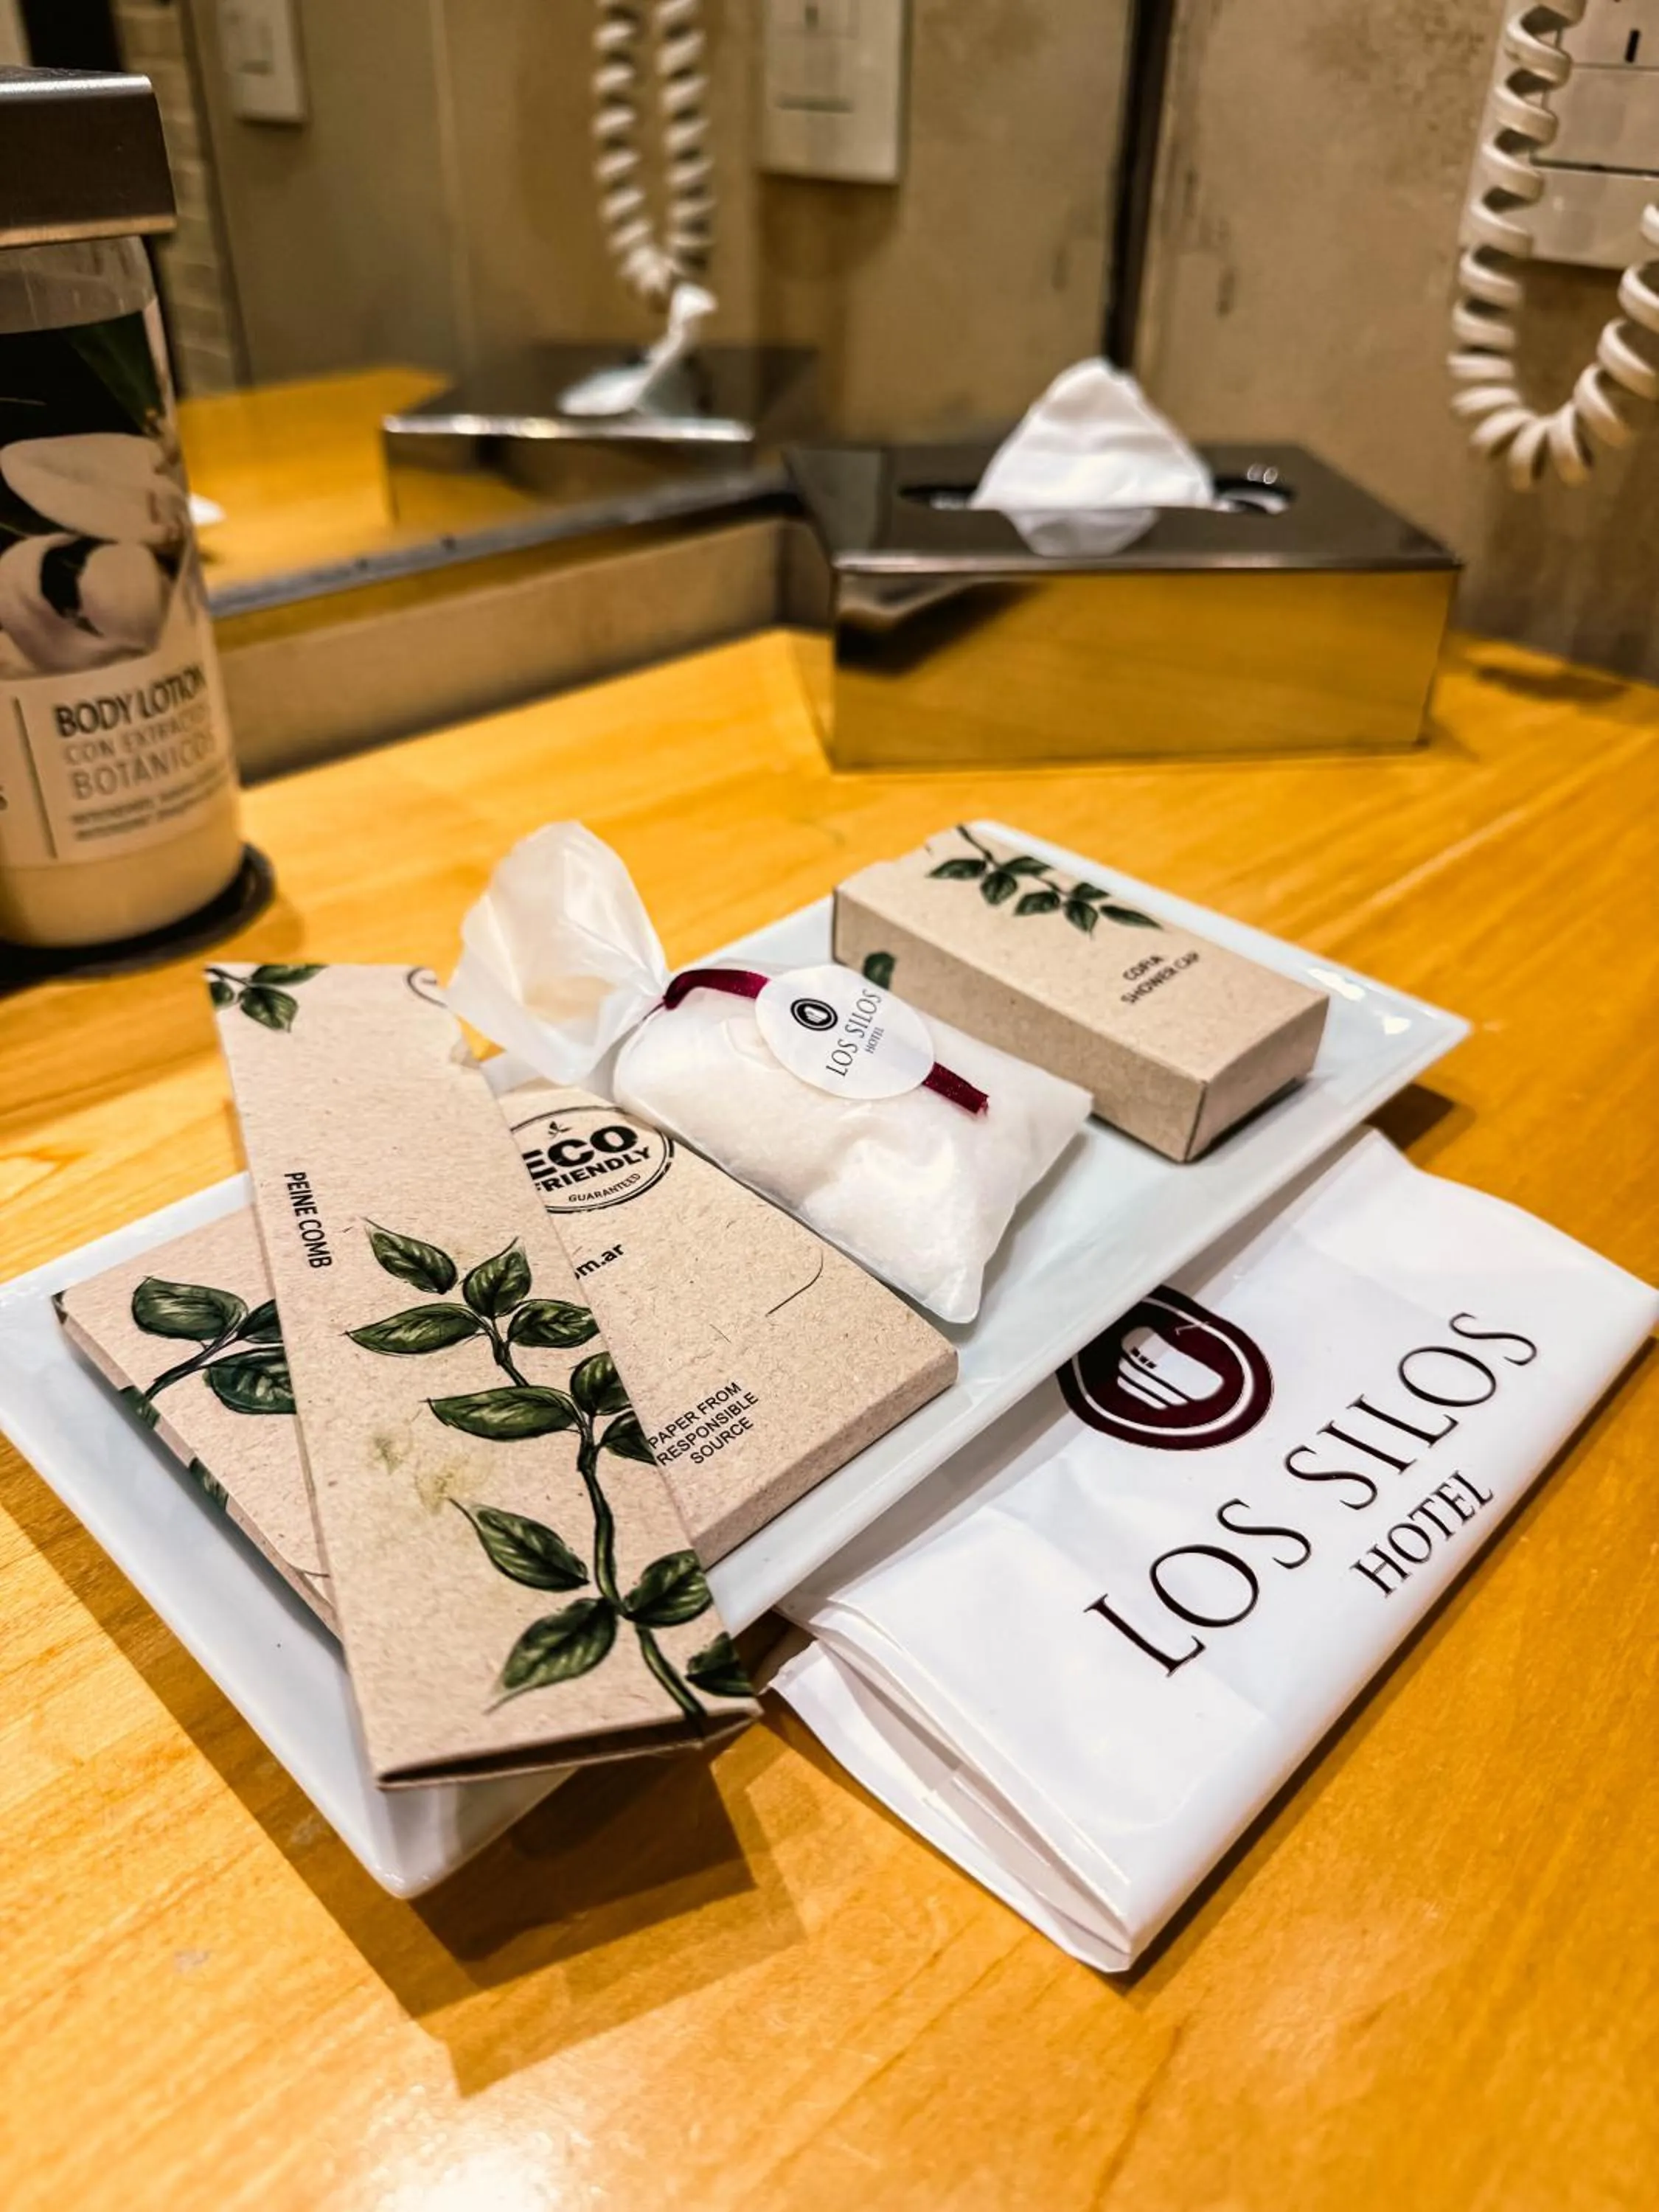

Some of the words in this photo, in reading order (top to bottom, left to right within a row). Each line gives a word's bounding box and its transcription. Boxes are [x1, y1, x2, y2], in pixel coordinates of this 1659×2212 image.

[54, 693, 133, 738] BODY
[137, 665, 206, 719] LOTION
[64, 739, 115, 765] CON
[72, 728, 216, 800] BOTANICO
[1120, 966, 1178, 1004] SHOWER
[1174, 951, 1200, 970] CAP
[825, 1038, 858, 1077] LOS
[844, 989, 882, 1038] SILOS
[864, 1026, 885, 1054] HOTEL
[521, 1125, 639, 1180] ECO
[284, 1172, 319, 1217] PEINE
[568, 1172, 641, 1203] GUARANTEED
[299, 1219, 333, 1268] COMB
[574, 1244, 625, 1280] m.ar
[647, 1411, 700, 1450] PAPER
[696, 1381, 742, 1415] FROM
[656, 1391, 759, 1466] RESPONSIBLE
[689, 1416, 754, 1464] SOURCE
[1084, 1498, 1312, 1677] LOS
[1283, 1312, 1537, 1512] SILOS
[1349, 1469, 1495, 1599] HOTEL
